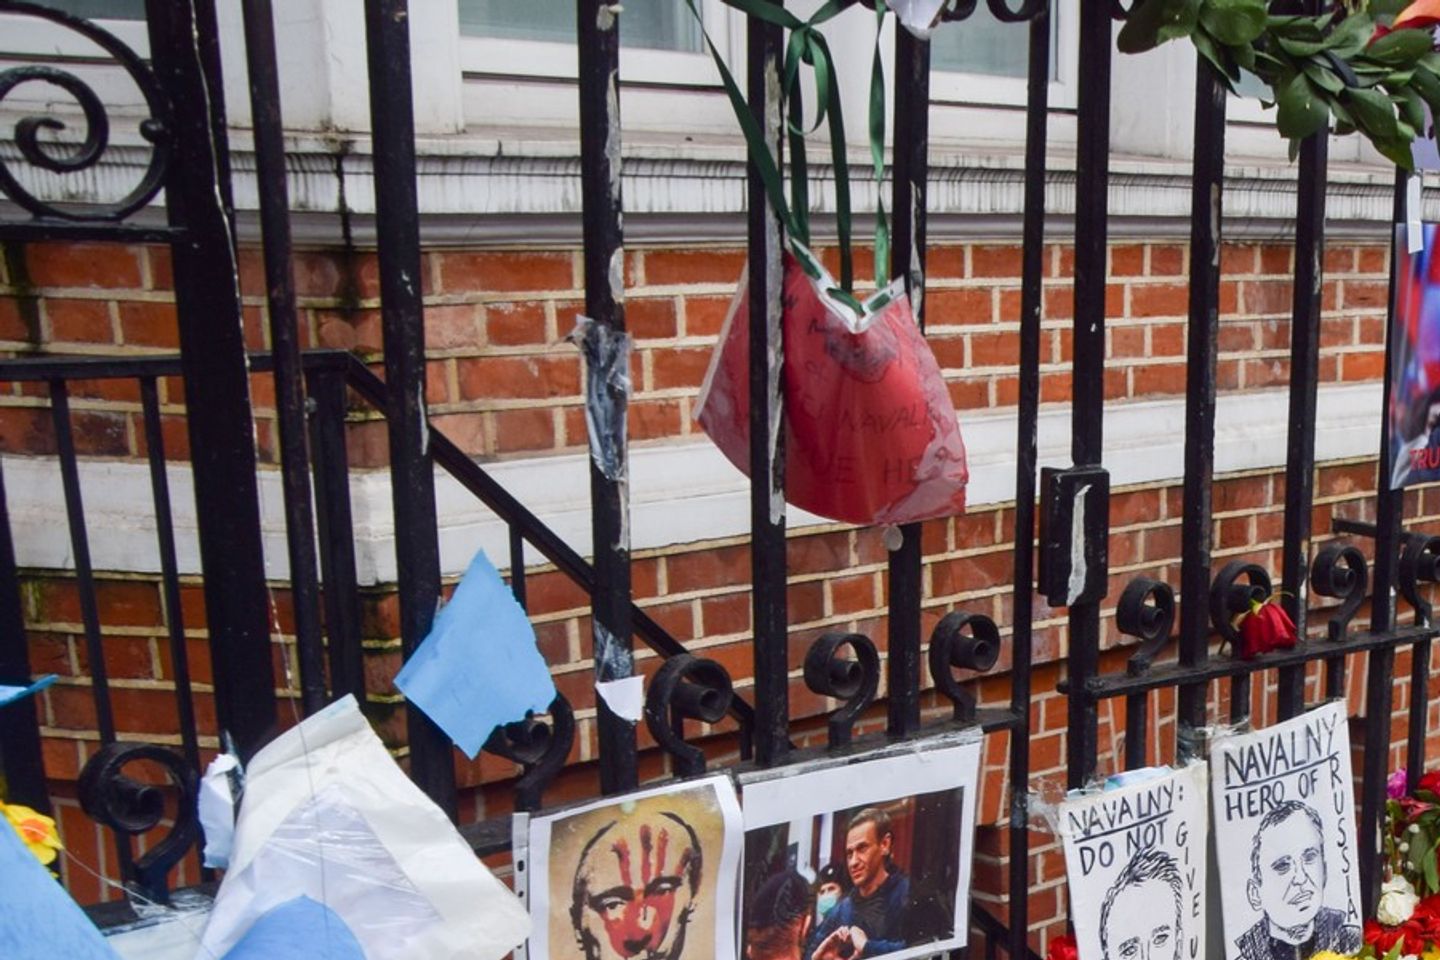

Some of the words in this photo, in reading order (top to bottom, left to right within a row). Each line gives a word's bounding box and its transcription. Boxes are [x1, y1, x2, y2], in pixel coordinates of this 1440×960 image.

[1224, 713, 1339, 785] NAVALNY
[1068, 780, 1185, 839] NAVALNY:
[1225, 782, 1286, 821] HERO
[1298, 768, 1320, 800] OF
[1079, 845, 1114, 876] DO
[1126, 819, 1168, 858] NOT
